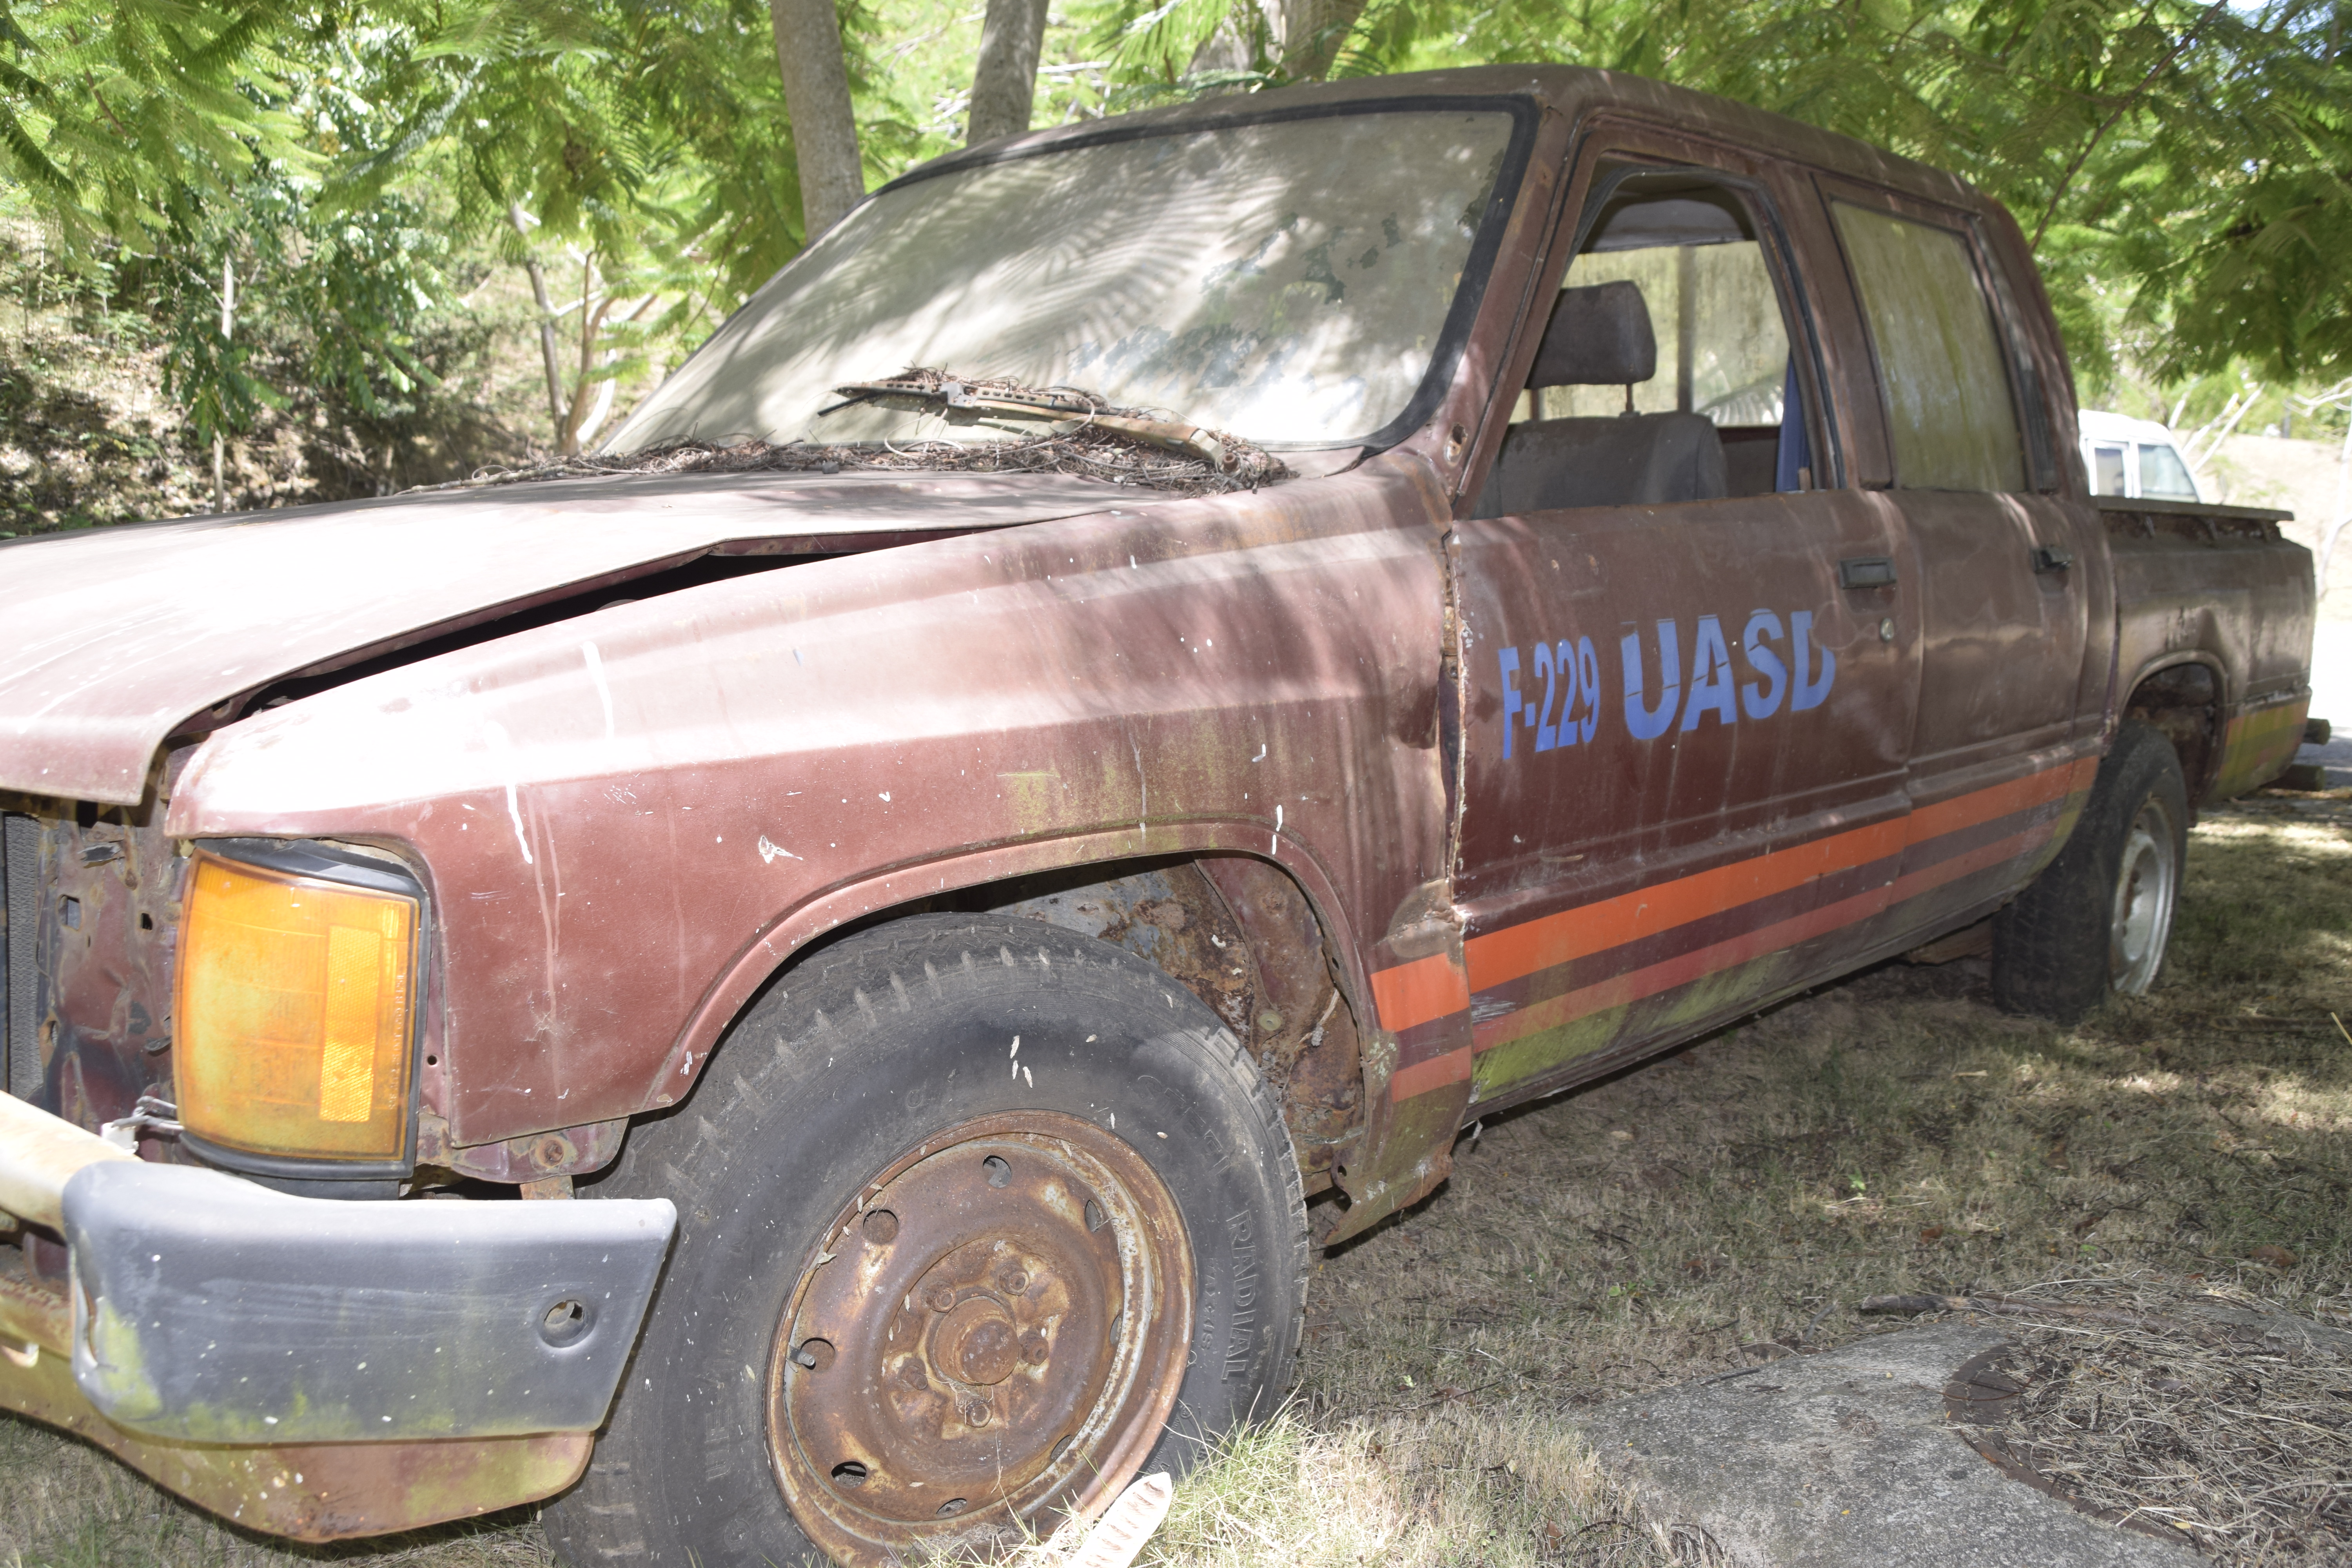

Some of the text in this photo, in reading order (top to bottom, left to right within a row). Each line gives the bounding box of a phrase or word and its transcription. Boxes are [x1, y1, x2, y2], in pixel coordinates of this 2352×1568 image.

[1498, 608, 1836, 760] F-229 UASD
[1221, 1210, 1257, 1383] RADIAL
